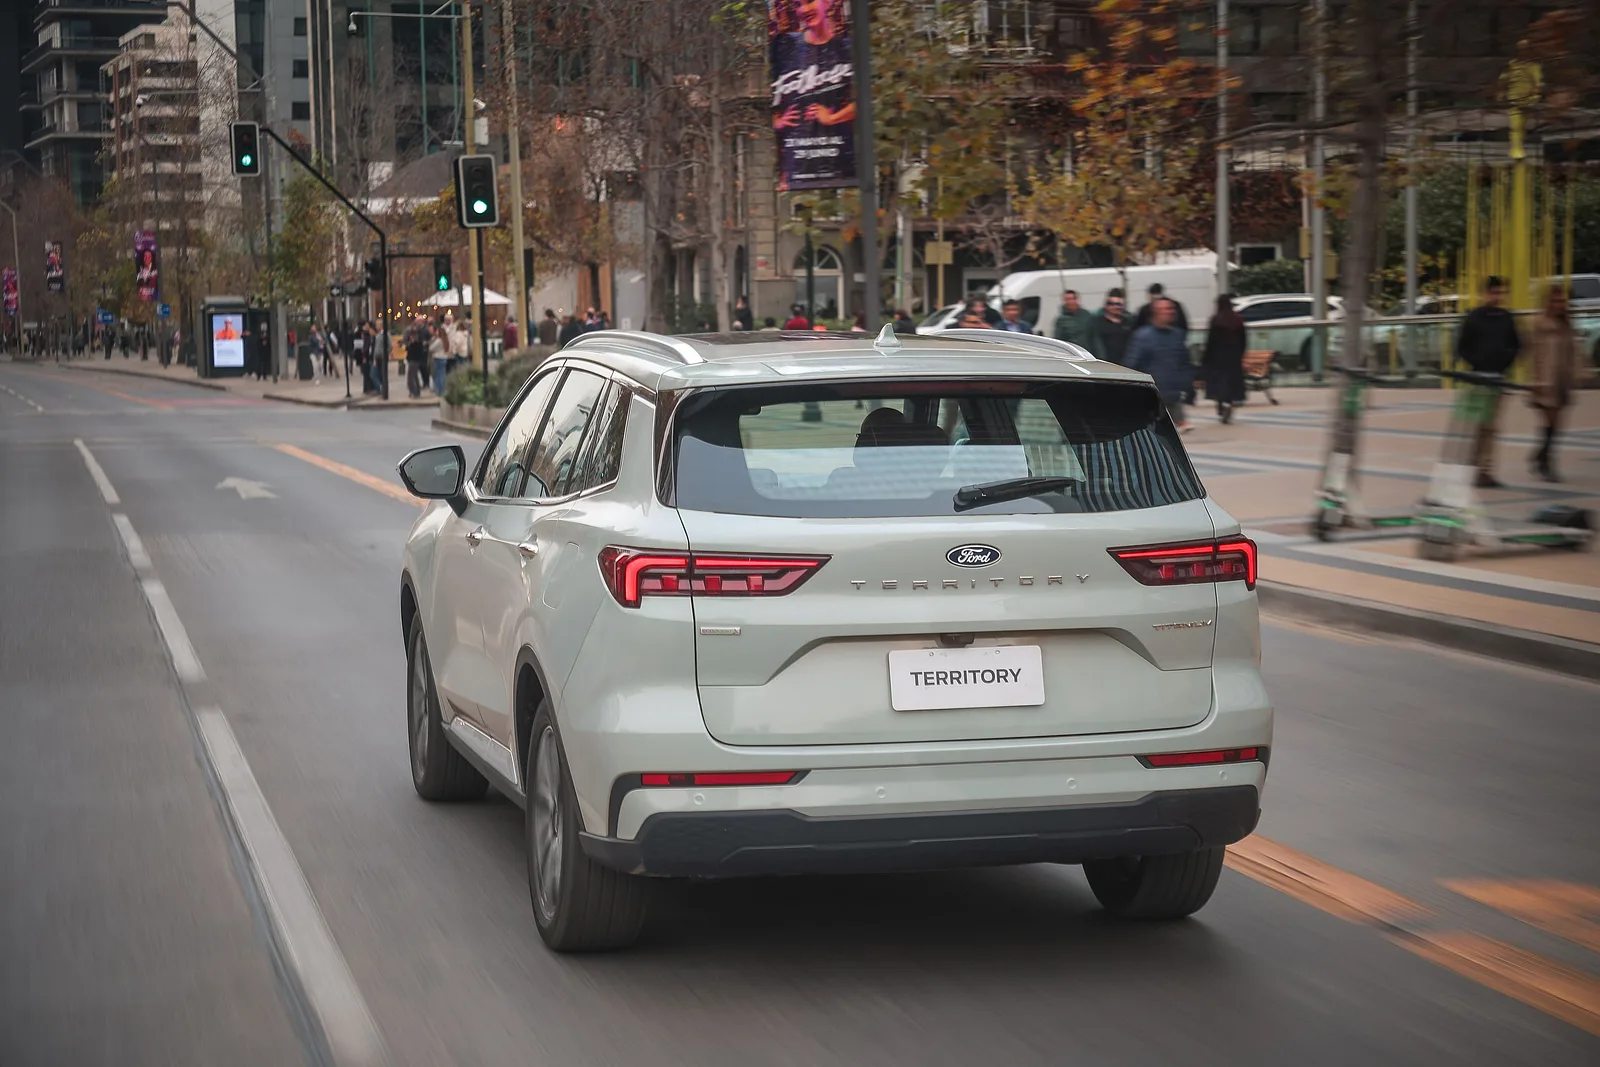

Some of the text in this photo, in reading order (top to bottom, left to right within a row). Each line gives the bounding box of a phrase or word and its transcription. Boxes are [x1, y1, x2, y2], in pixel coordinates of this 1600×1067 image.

[957, 547, 992, 564] Ford
[850, 573, 1091, 591] TERRITORY
[909, 668, 1022, 687] TERRITORY
